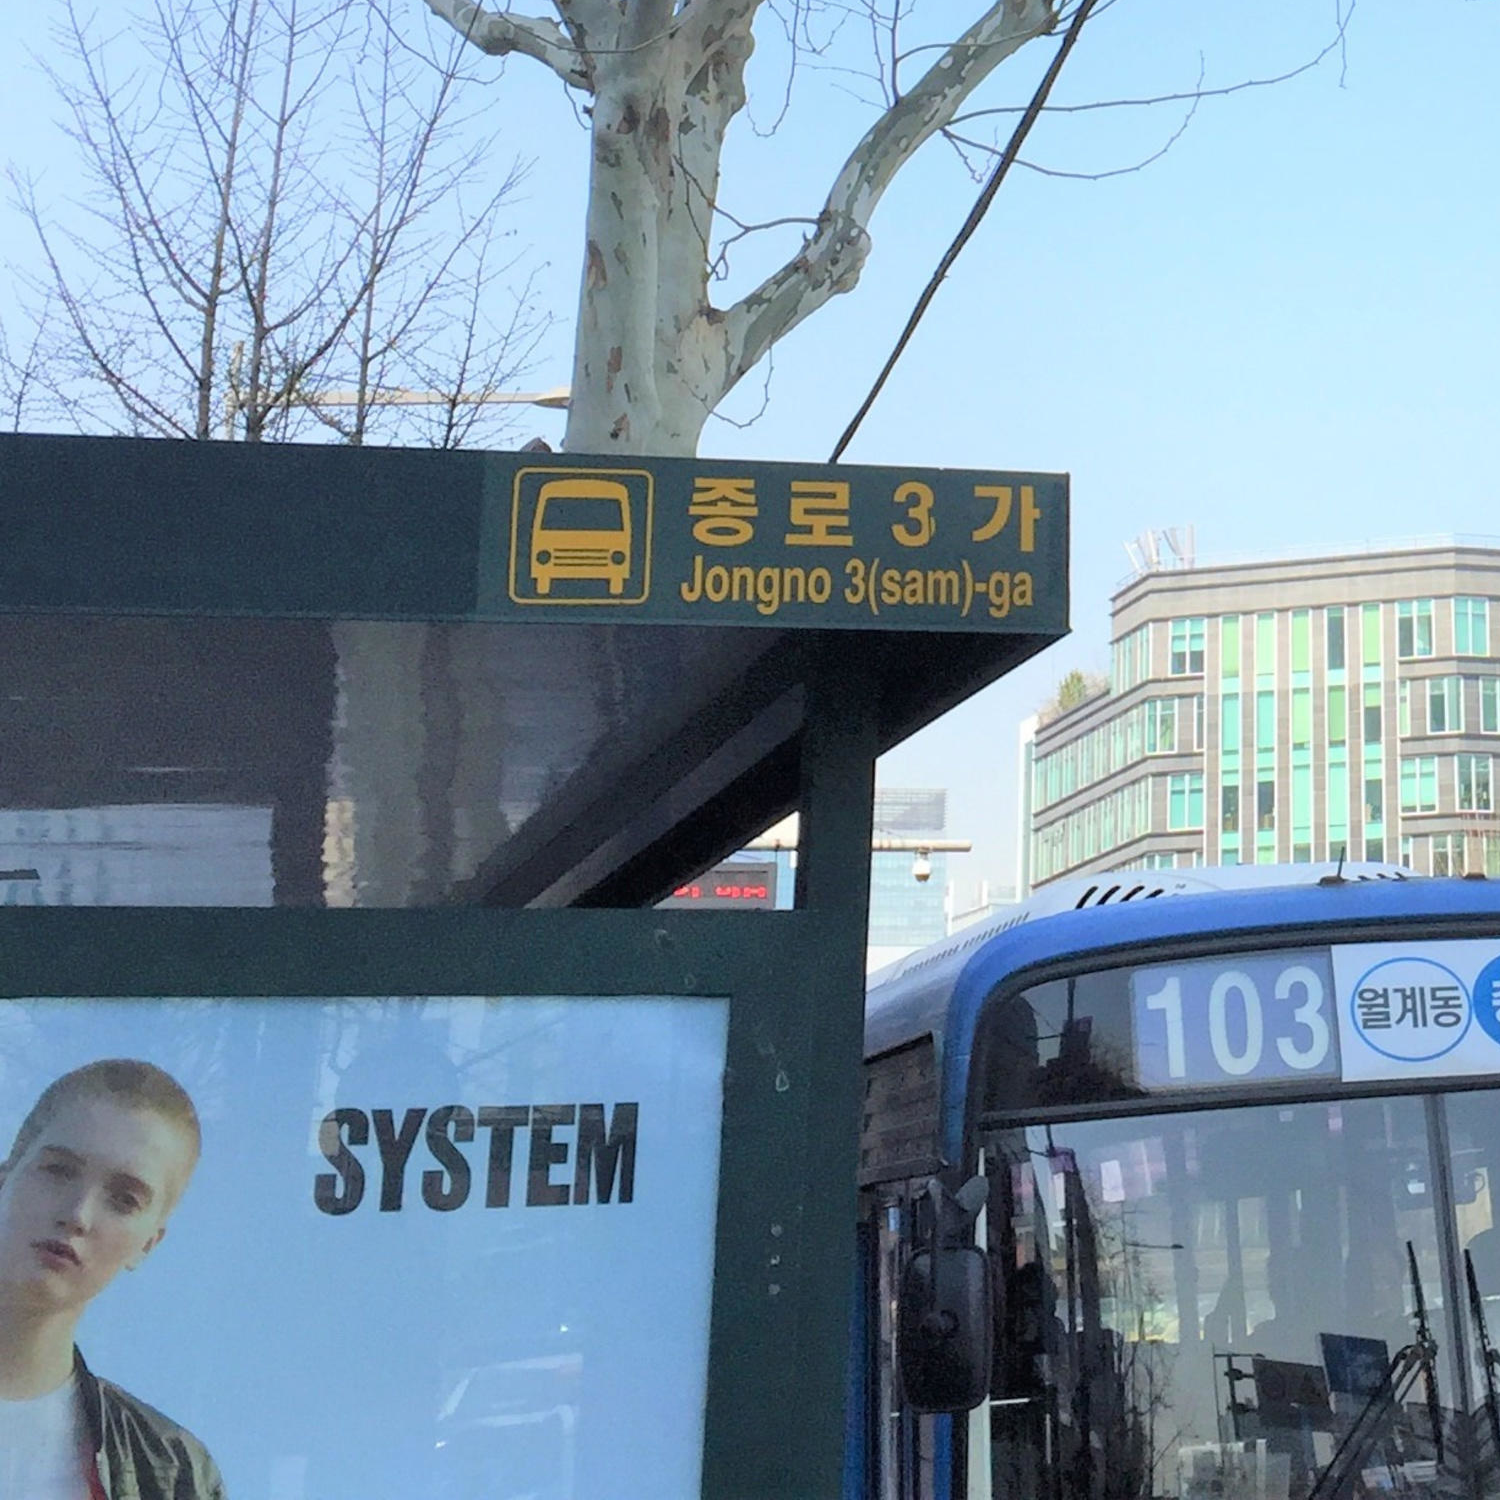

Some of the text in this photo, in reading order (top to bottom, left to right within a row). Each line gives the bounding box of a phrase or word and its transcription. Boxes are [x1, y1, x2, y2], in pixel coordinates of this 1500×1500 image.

[680, 555, 1034, 618] Jongno 3(sam)-ga
[1145, 964, 1332, 1079] 103
[1356, 984, 1464, 1030] 월계동
[313, 1102, 639, 1217] SYSTEM
